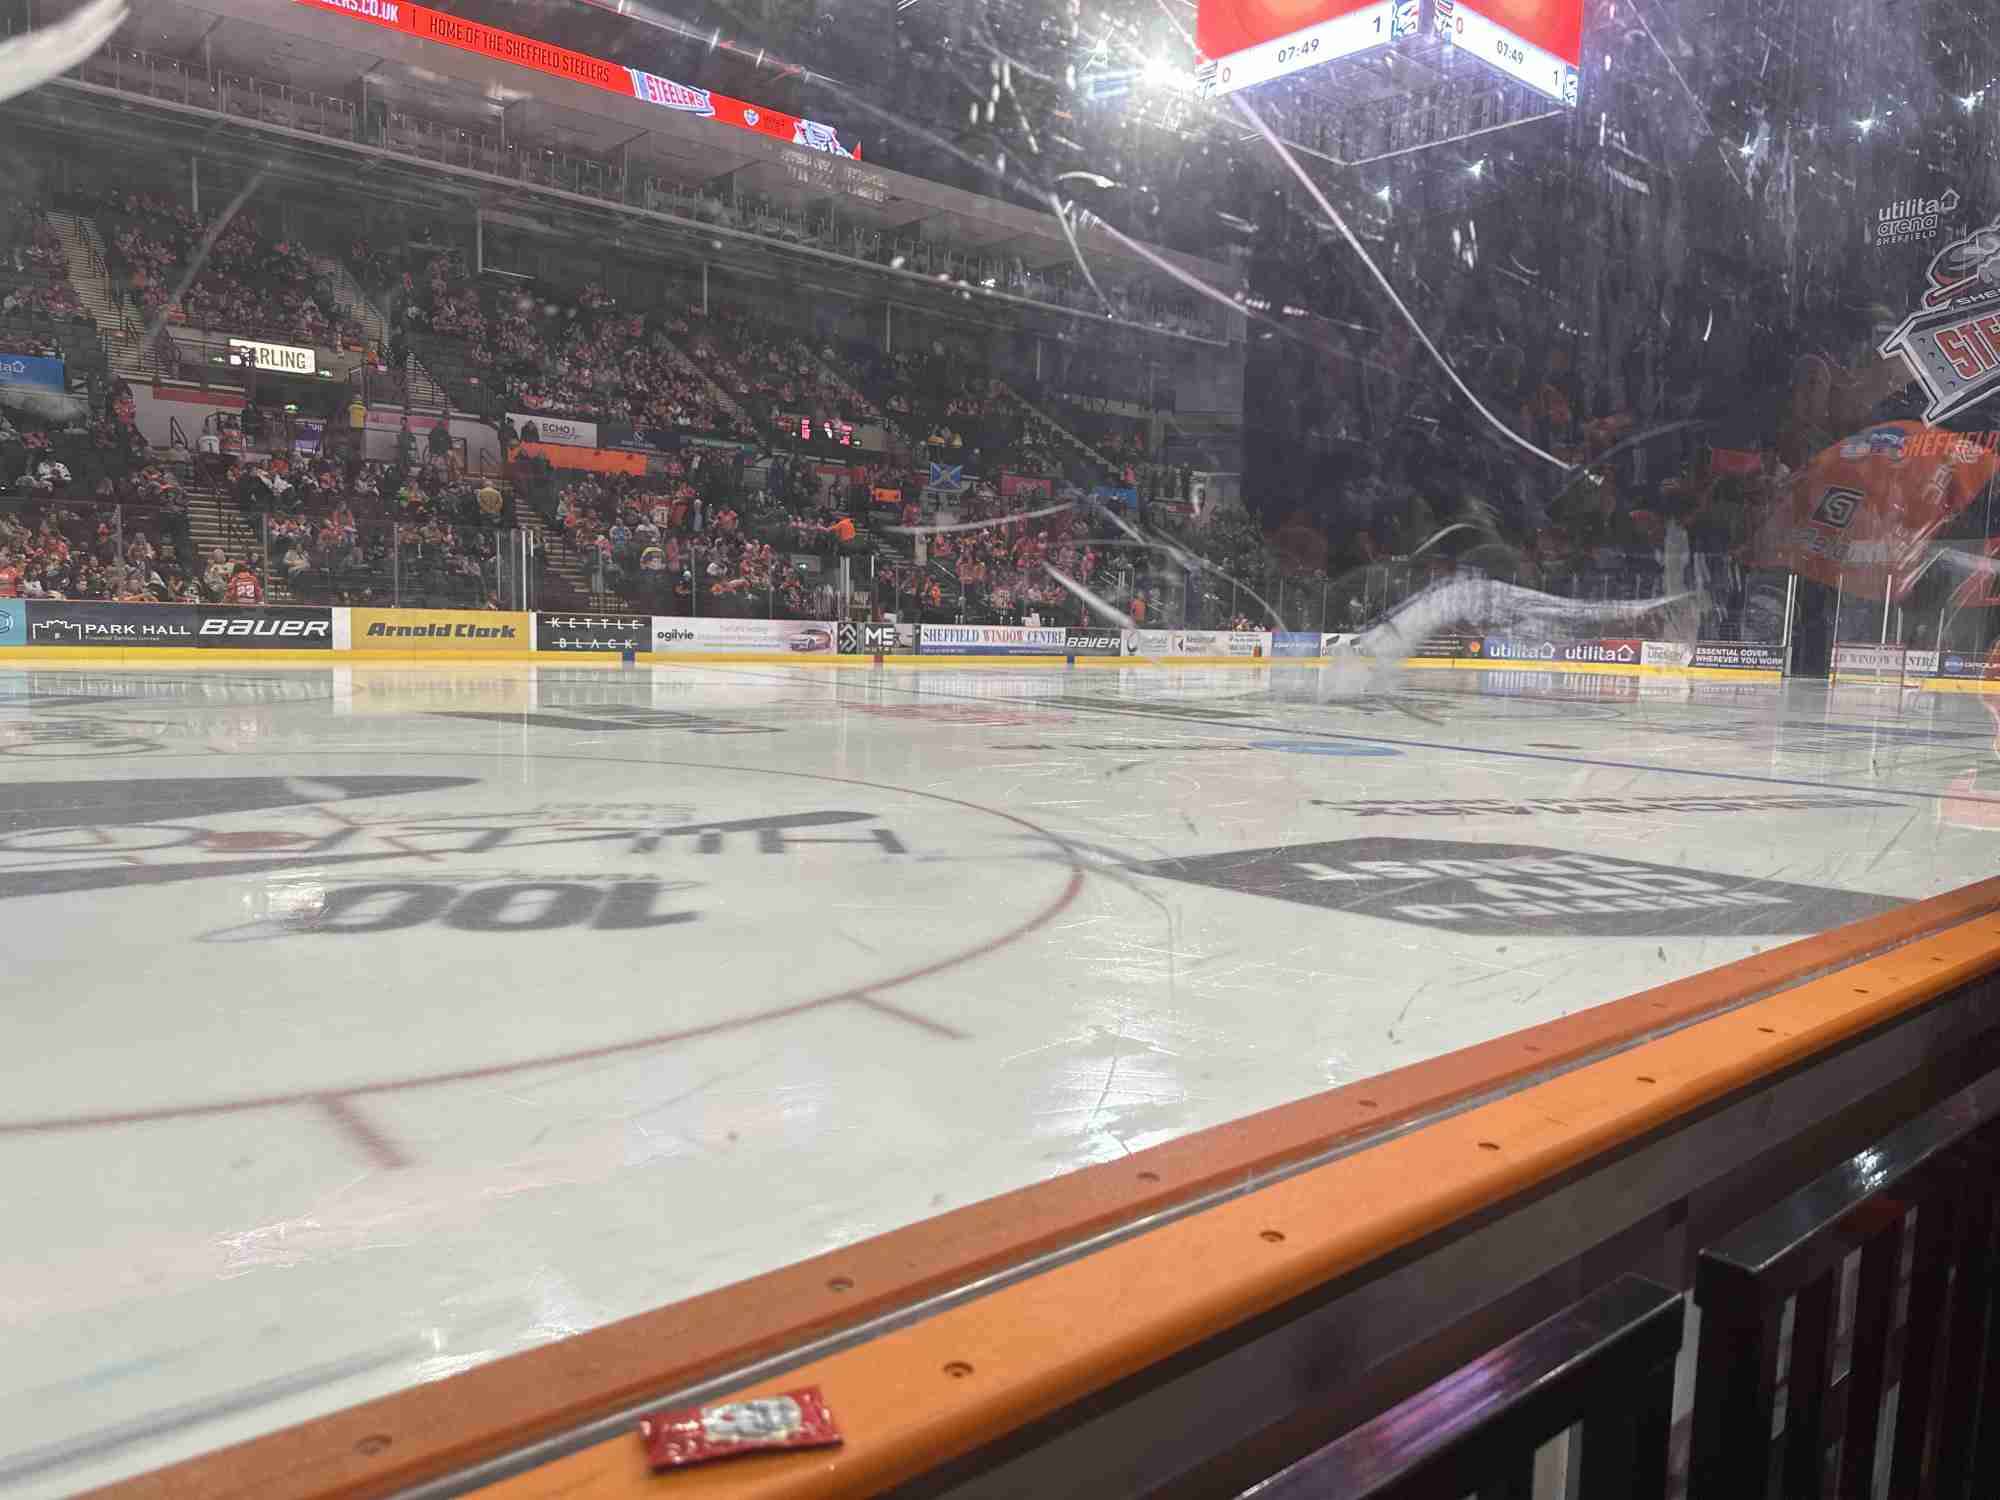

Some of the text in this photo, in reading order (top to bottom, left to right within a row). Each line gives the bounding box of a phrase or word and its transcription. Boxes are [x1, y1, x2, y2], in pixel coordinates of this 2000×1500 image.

[1373, 16, 1381, 32] 1
[430, 16, 609, 82] HOME OF THE SHEFFIELD STEELERS
[1278, 38, 1319, 63] 07:49
[1497, 40, 1524, 64] 07:49
[1222, 66, 1231, 83] 0
[645, 74, 704, 107] STEELERS
[1879, 198, 1939, 221] utilita
[1878, 214, 1938, 236] arena
[1876, 230, 1936, 246] SHEFFIELD
[1957, 288, 2000, 304] SHE
[85, 624, 192, 635] PARK HALL
[367, 623, 516, 638] Arnold Clark
[551, 617, 641, 629] KETTLE
[559, 637, 634, 649] BLACK
[657, 629, 694, 641] ogilvie
[923, 629, 1064, 644] SHEFFIELD WINDOW CENTRE
[1490, 643, 1538, 659] utilita
[1565, 646, 1616, 661] utilita
[1696, 648, 1737, 656] ESSENTIAL
[1695, 656, 1784, 666] WHEREVER YOU WORK
[1468, 873, 1729, 900] CITY
[1394, 890, 1793, 920] SHEFFIELD
